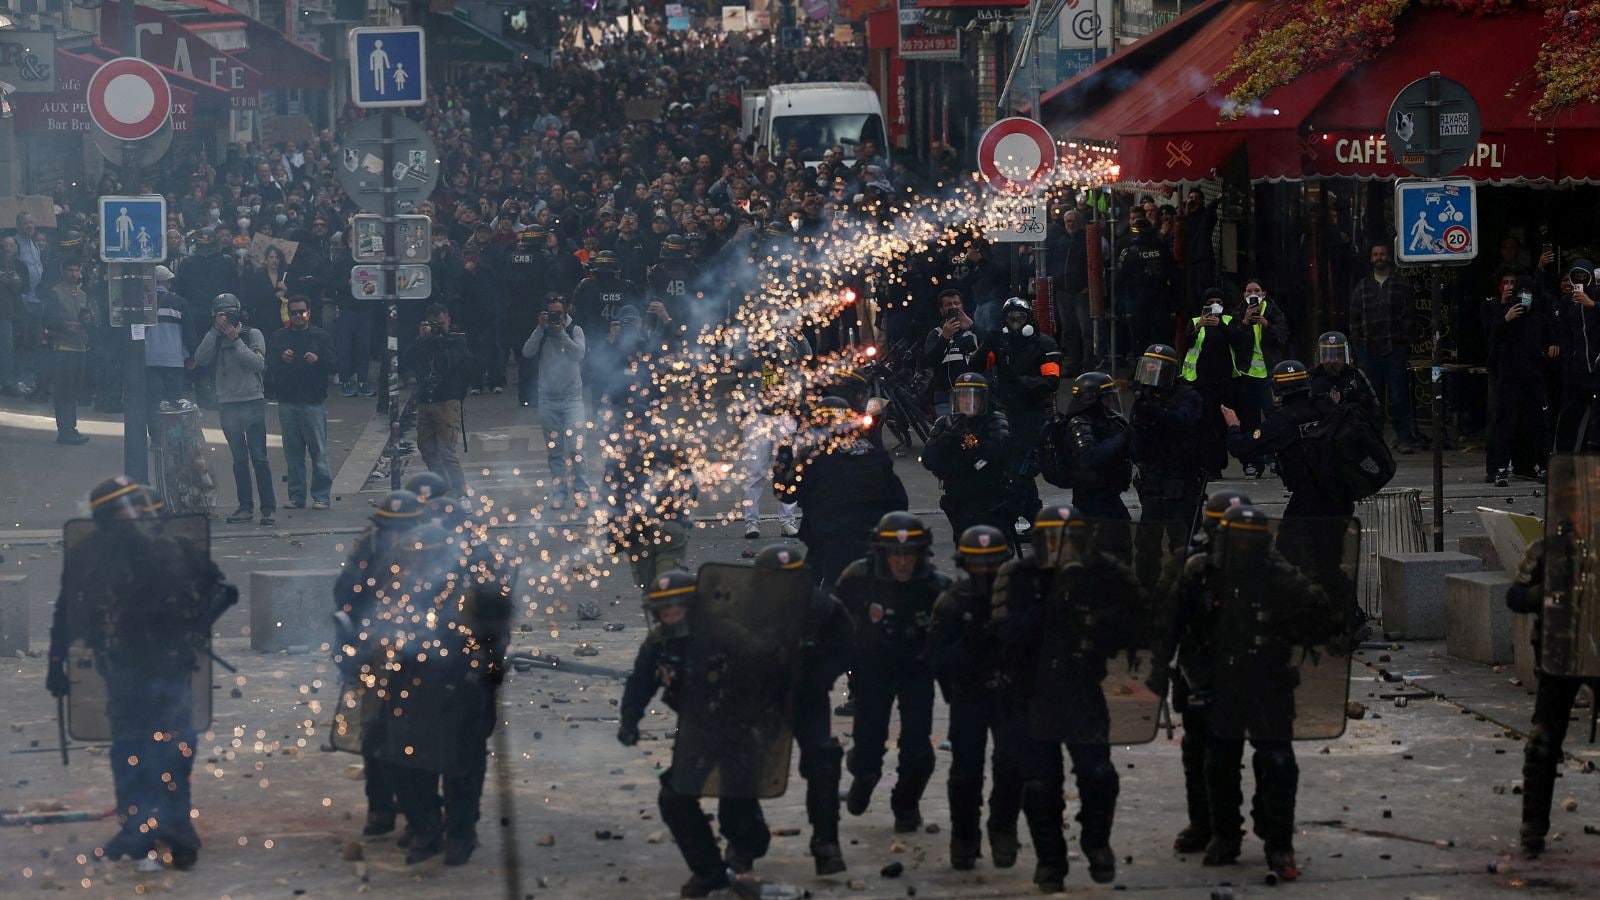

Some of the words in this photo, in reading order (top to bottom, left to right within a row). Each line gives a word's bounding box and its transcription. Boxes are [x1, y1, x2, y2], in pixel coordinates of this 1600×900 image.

[977, 9, 1001, 19] BAR
[913, 39, 923, 49] 70
[924, 39, 934, 49] 24
[897, 76, 906, 125] PASTA
[42, 103, 69, 113] AUX
[72, 103, 87, 113] PE
[170, 104, 187, 113] UX
[48, 119, 68, 130] Bar
[72, 119, 92, 130] Bra
[1440, 124, 1468, 134] TATTOO
[1335, 134, 1387, 164] CAFÉ
[1449, 234, 1465, 245] 20
[514, 255, 530, 263] CRS
[1142, 250, 1160, 259] CRS
[666, 280, 686, 296] 4B
[602, 294, 621, 302] CRS
